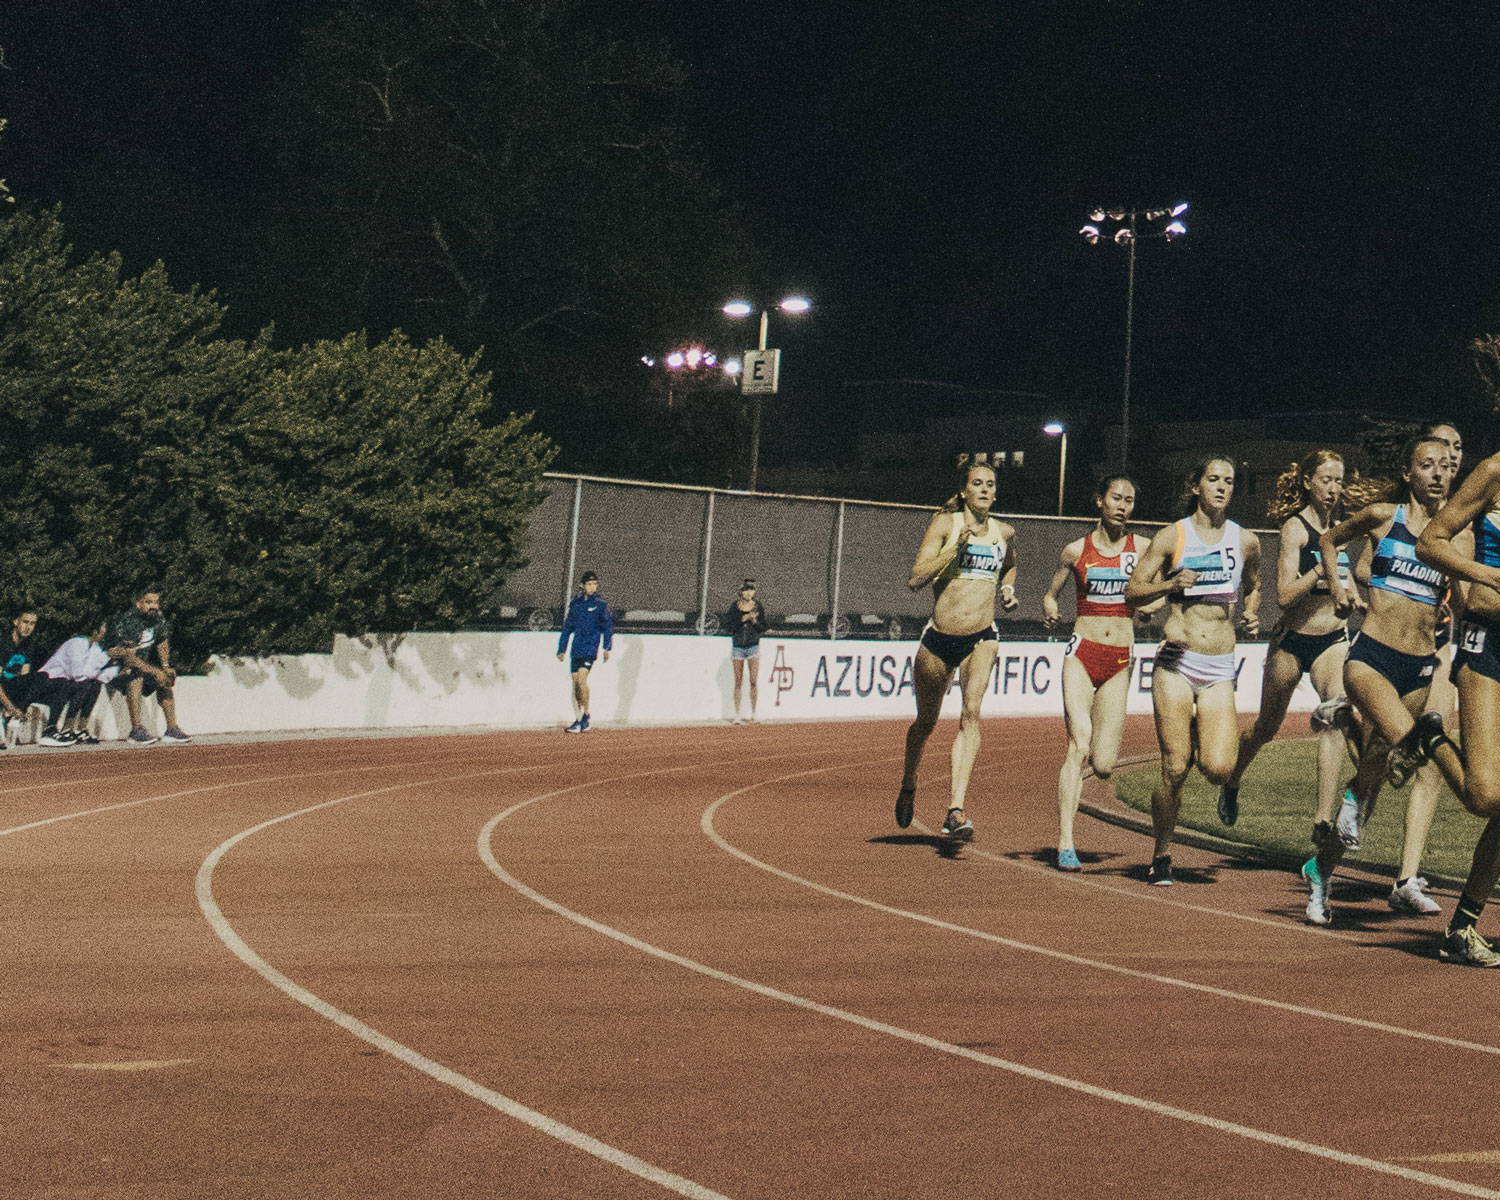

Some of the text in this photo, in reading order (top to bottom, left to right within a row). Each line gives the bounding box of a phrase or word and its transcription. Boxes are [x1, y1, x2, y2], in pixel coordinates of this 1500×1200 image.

[753, 361, 766, 380] E
[1124, 554, 1136, 576] 8
[1225, 547, 1236, 570] 5
[810, 655, 917, 698] AZUSA
